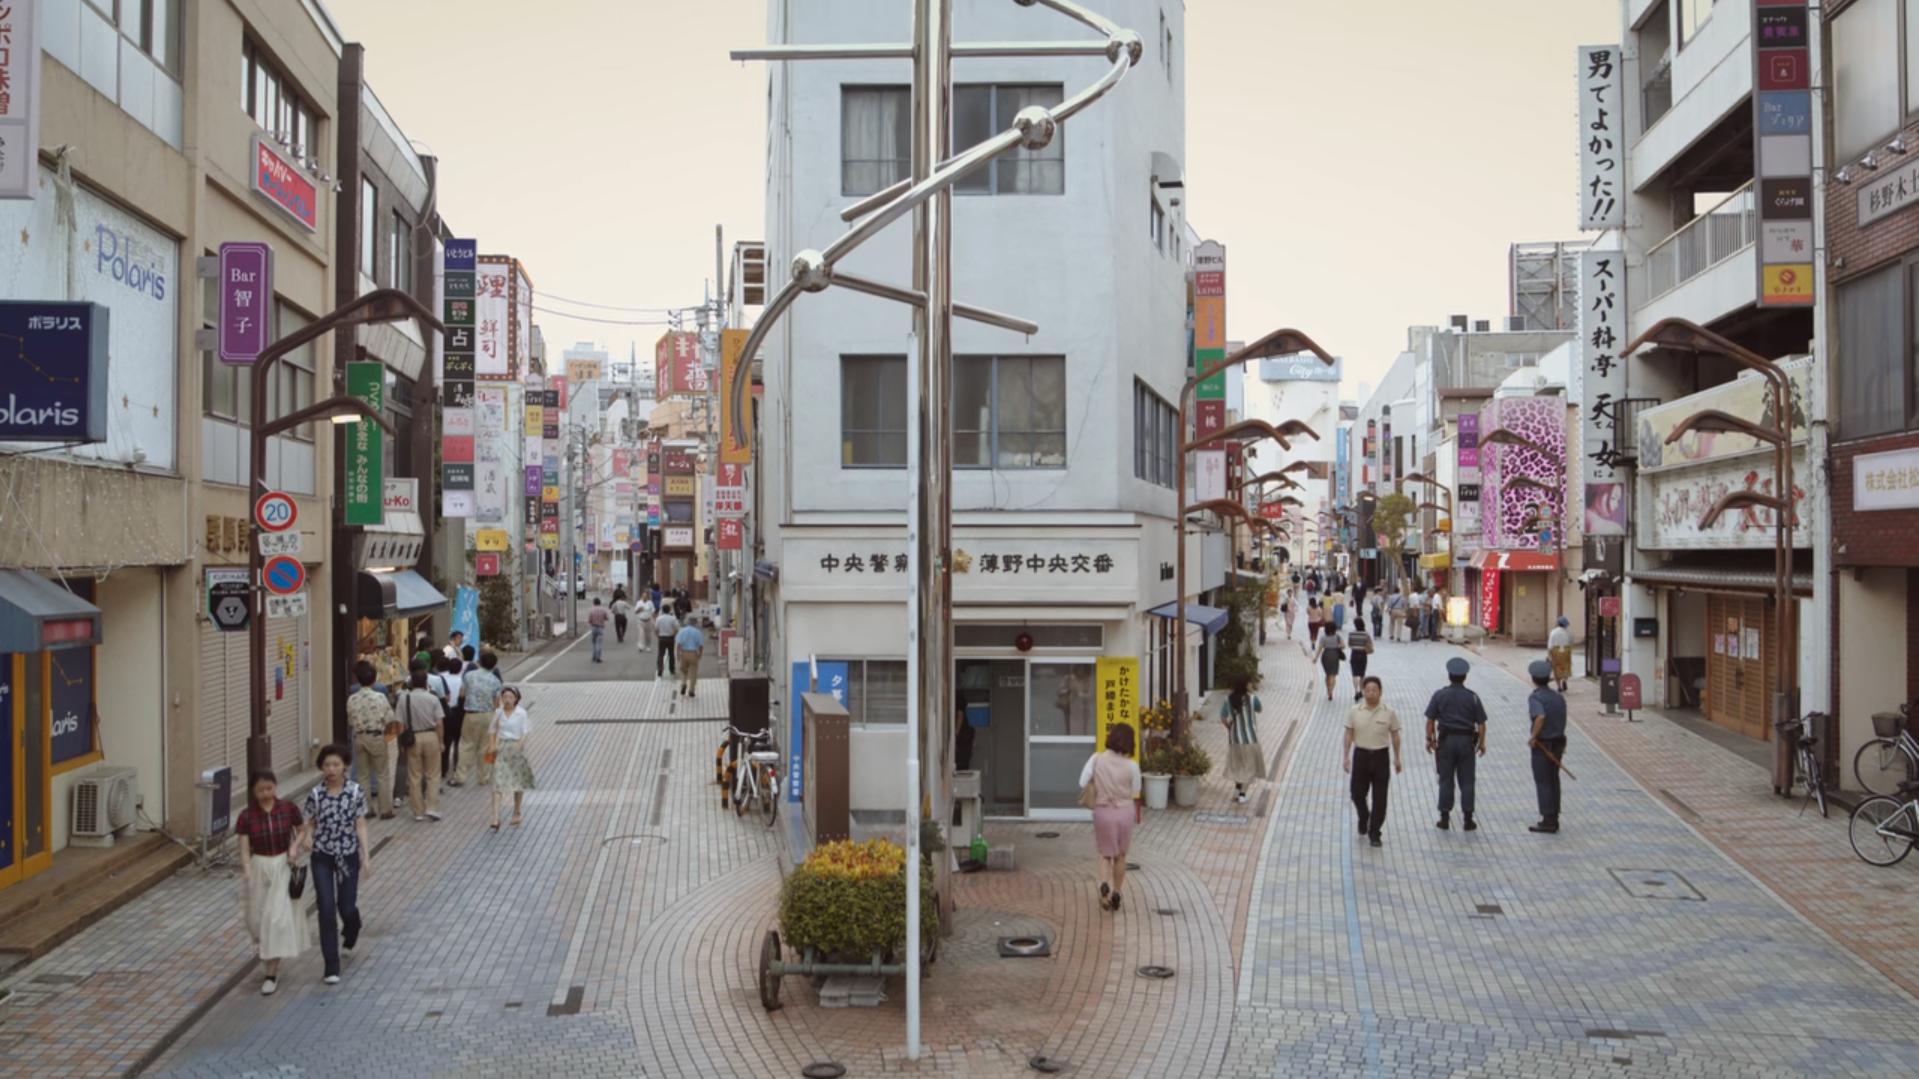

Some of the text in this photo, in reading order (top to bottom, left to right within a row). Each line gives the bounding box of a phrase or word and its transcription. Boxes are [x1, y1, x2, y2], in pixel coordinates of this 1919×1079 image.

[96, 223, 166, 301] Polaris
[231, 267, 257, 283] Bar
[28, 316, 82, 331] ポラリス
[234, 289, 253, 334] 智子
[1588, 259, 1621, 471] スーパー料亭 天女
[264, 503, 290, 522] 20
[979, 553, 1114, 574] 薄野中央交番
[1119, 666, 1130, 719] かけたかな
